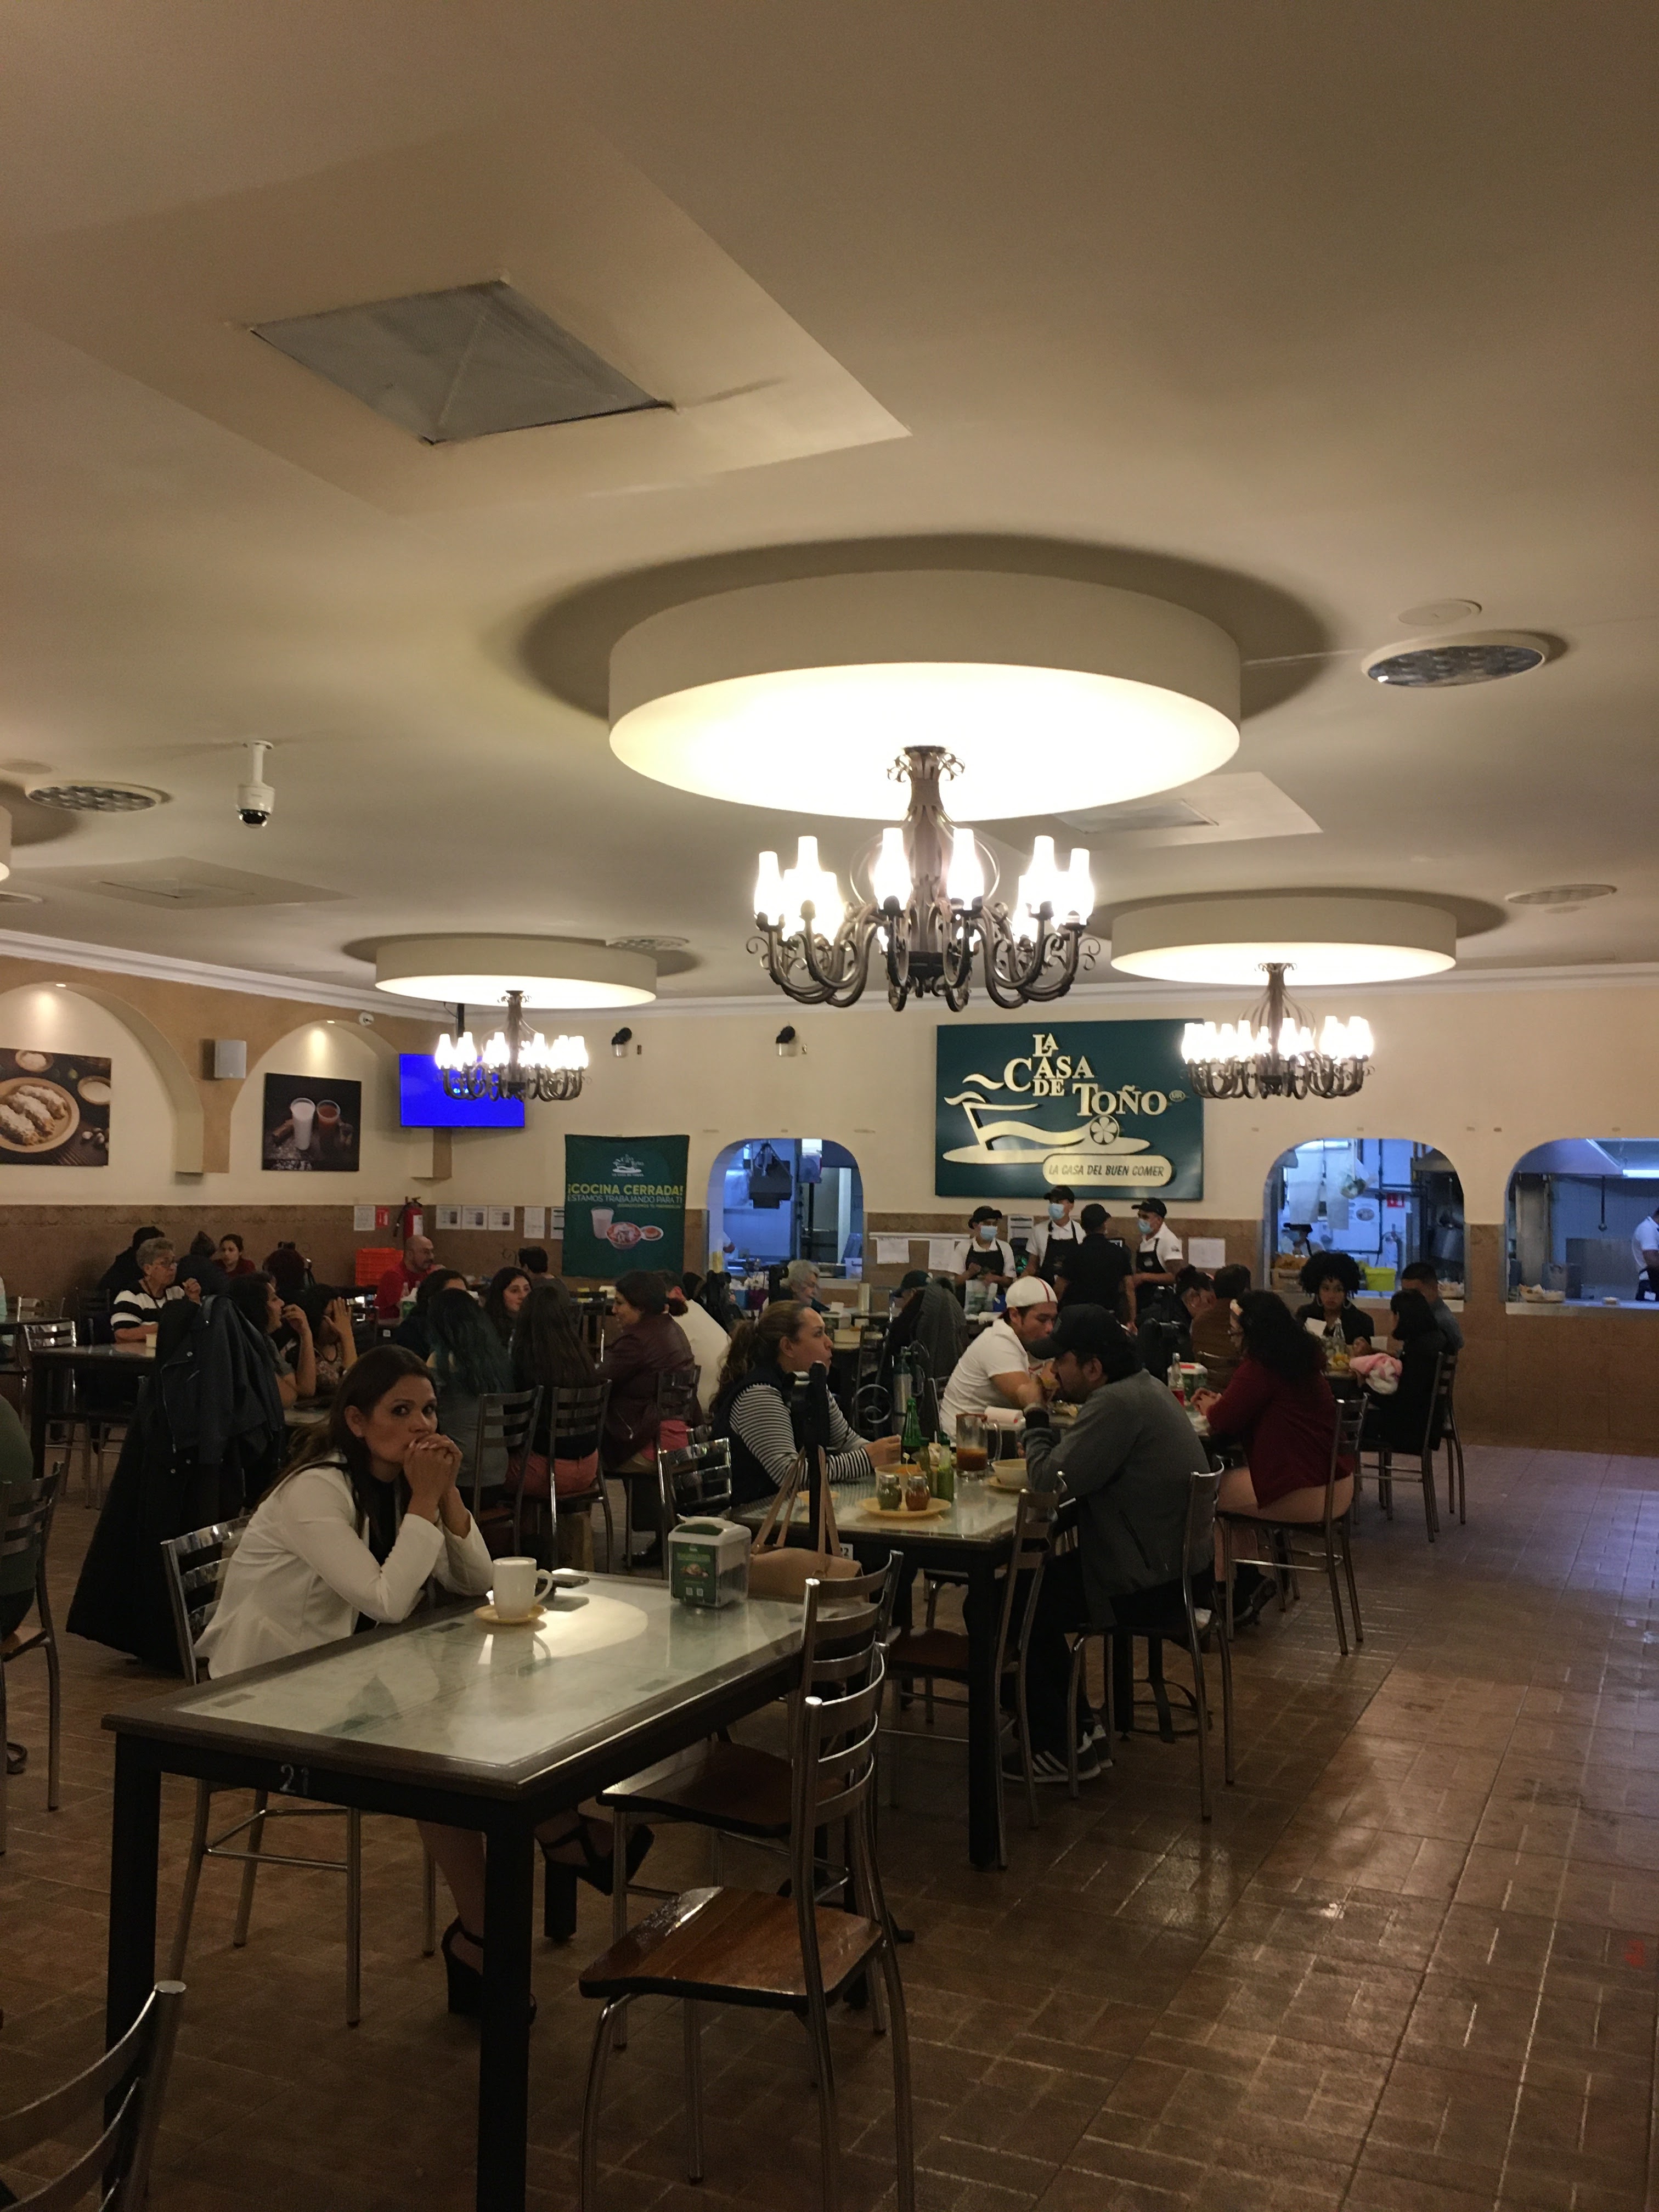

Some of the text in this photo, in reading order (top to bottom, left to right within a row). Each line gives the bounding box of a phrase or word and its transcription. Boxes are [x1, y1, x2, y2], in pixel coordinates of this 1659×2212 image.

[1032, 1032, 1059, 1057] LA
[1003, 1056, 1095, 1092] CASA
[1032, 1079, 1167, 1116] DE TOÑO
[1048, 1164, 1165, 1177] LA CASA DEL BUEN COMER
[605, 1195, 655, 1204] TRABAJANDO
[623, 1184, 684, 1196] CERRADA!
[279, 1763, 310, 1796] 21
